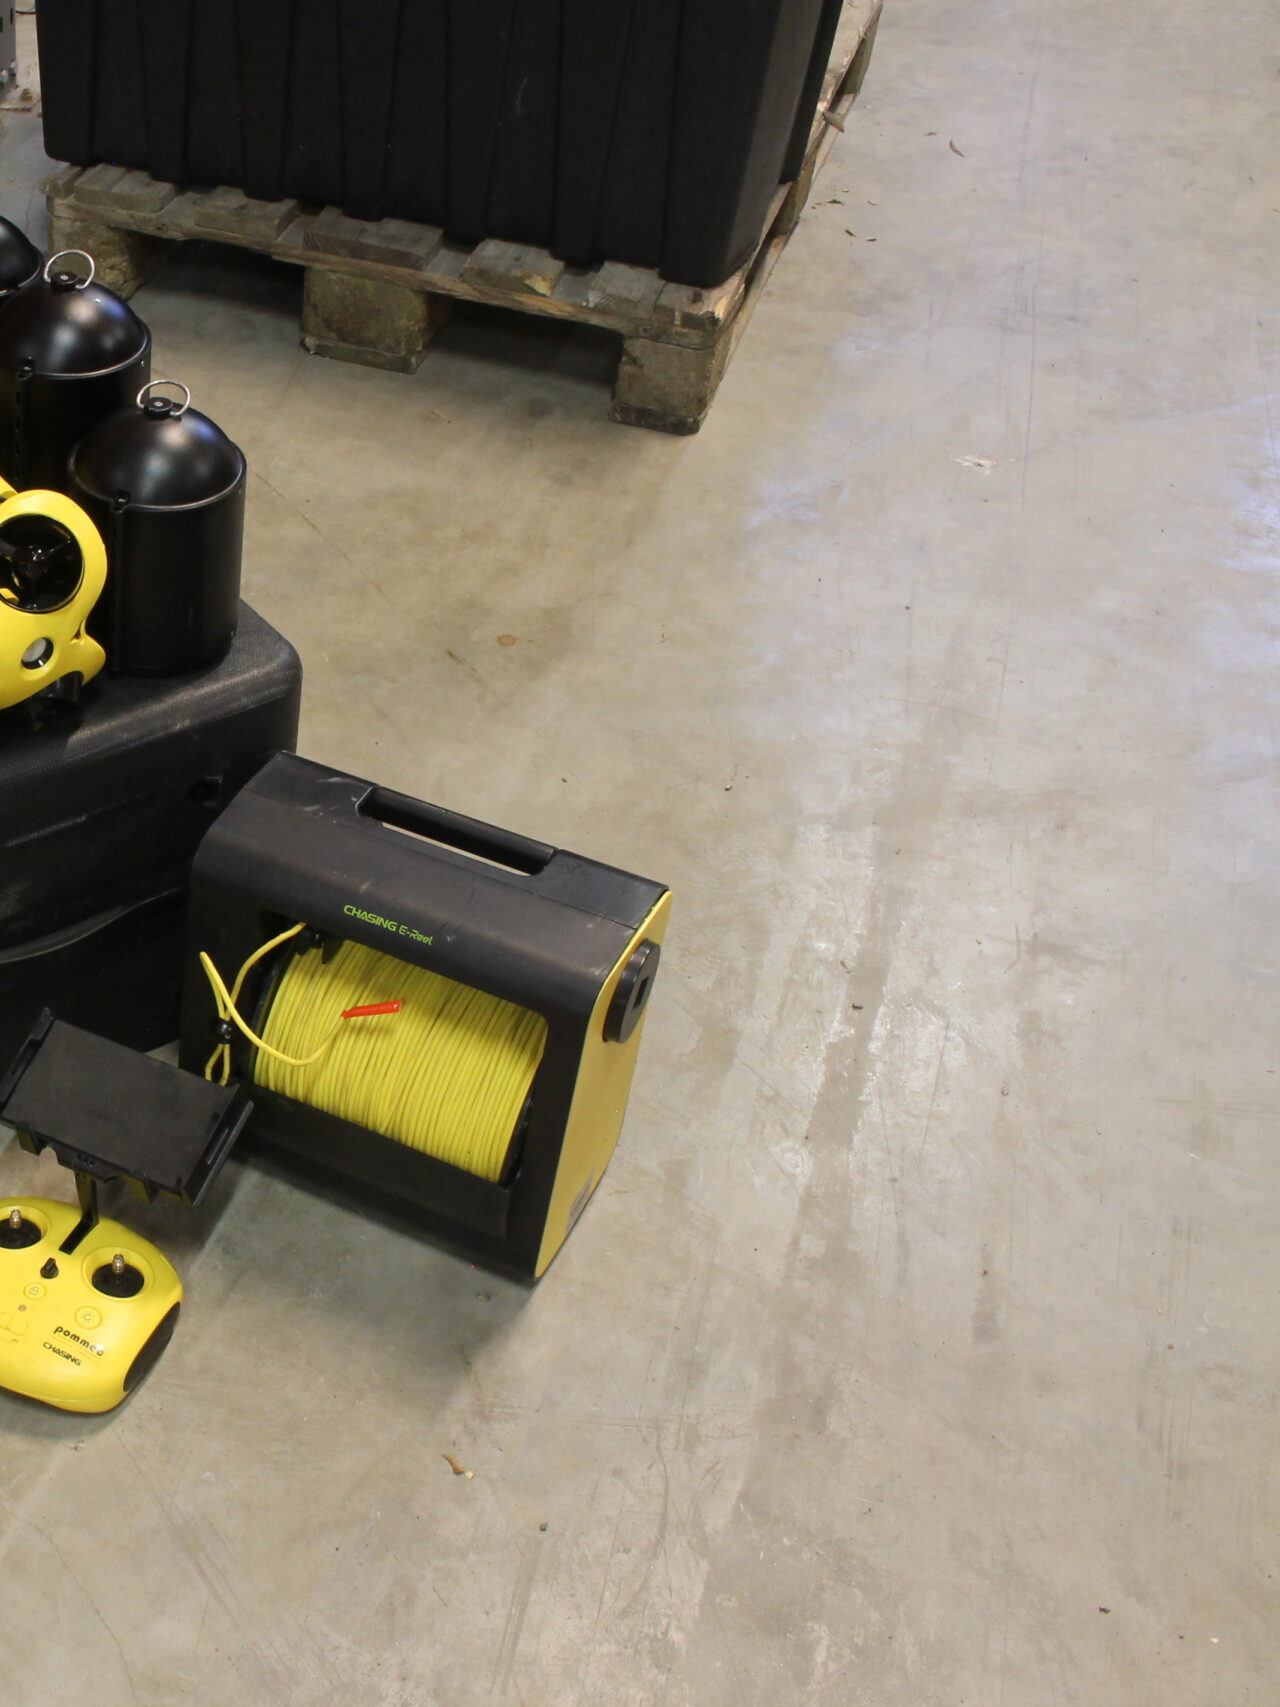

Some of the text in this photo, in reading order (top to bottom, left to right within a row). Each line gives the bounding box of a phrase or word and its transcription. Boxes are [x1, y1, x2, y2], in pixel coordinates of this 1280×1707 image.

[343, 904, 433, 946] CHASING E-Reel
[42, 1342, 81, 1366] CHASING
